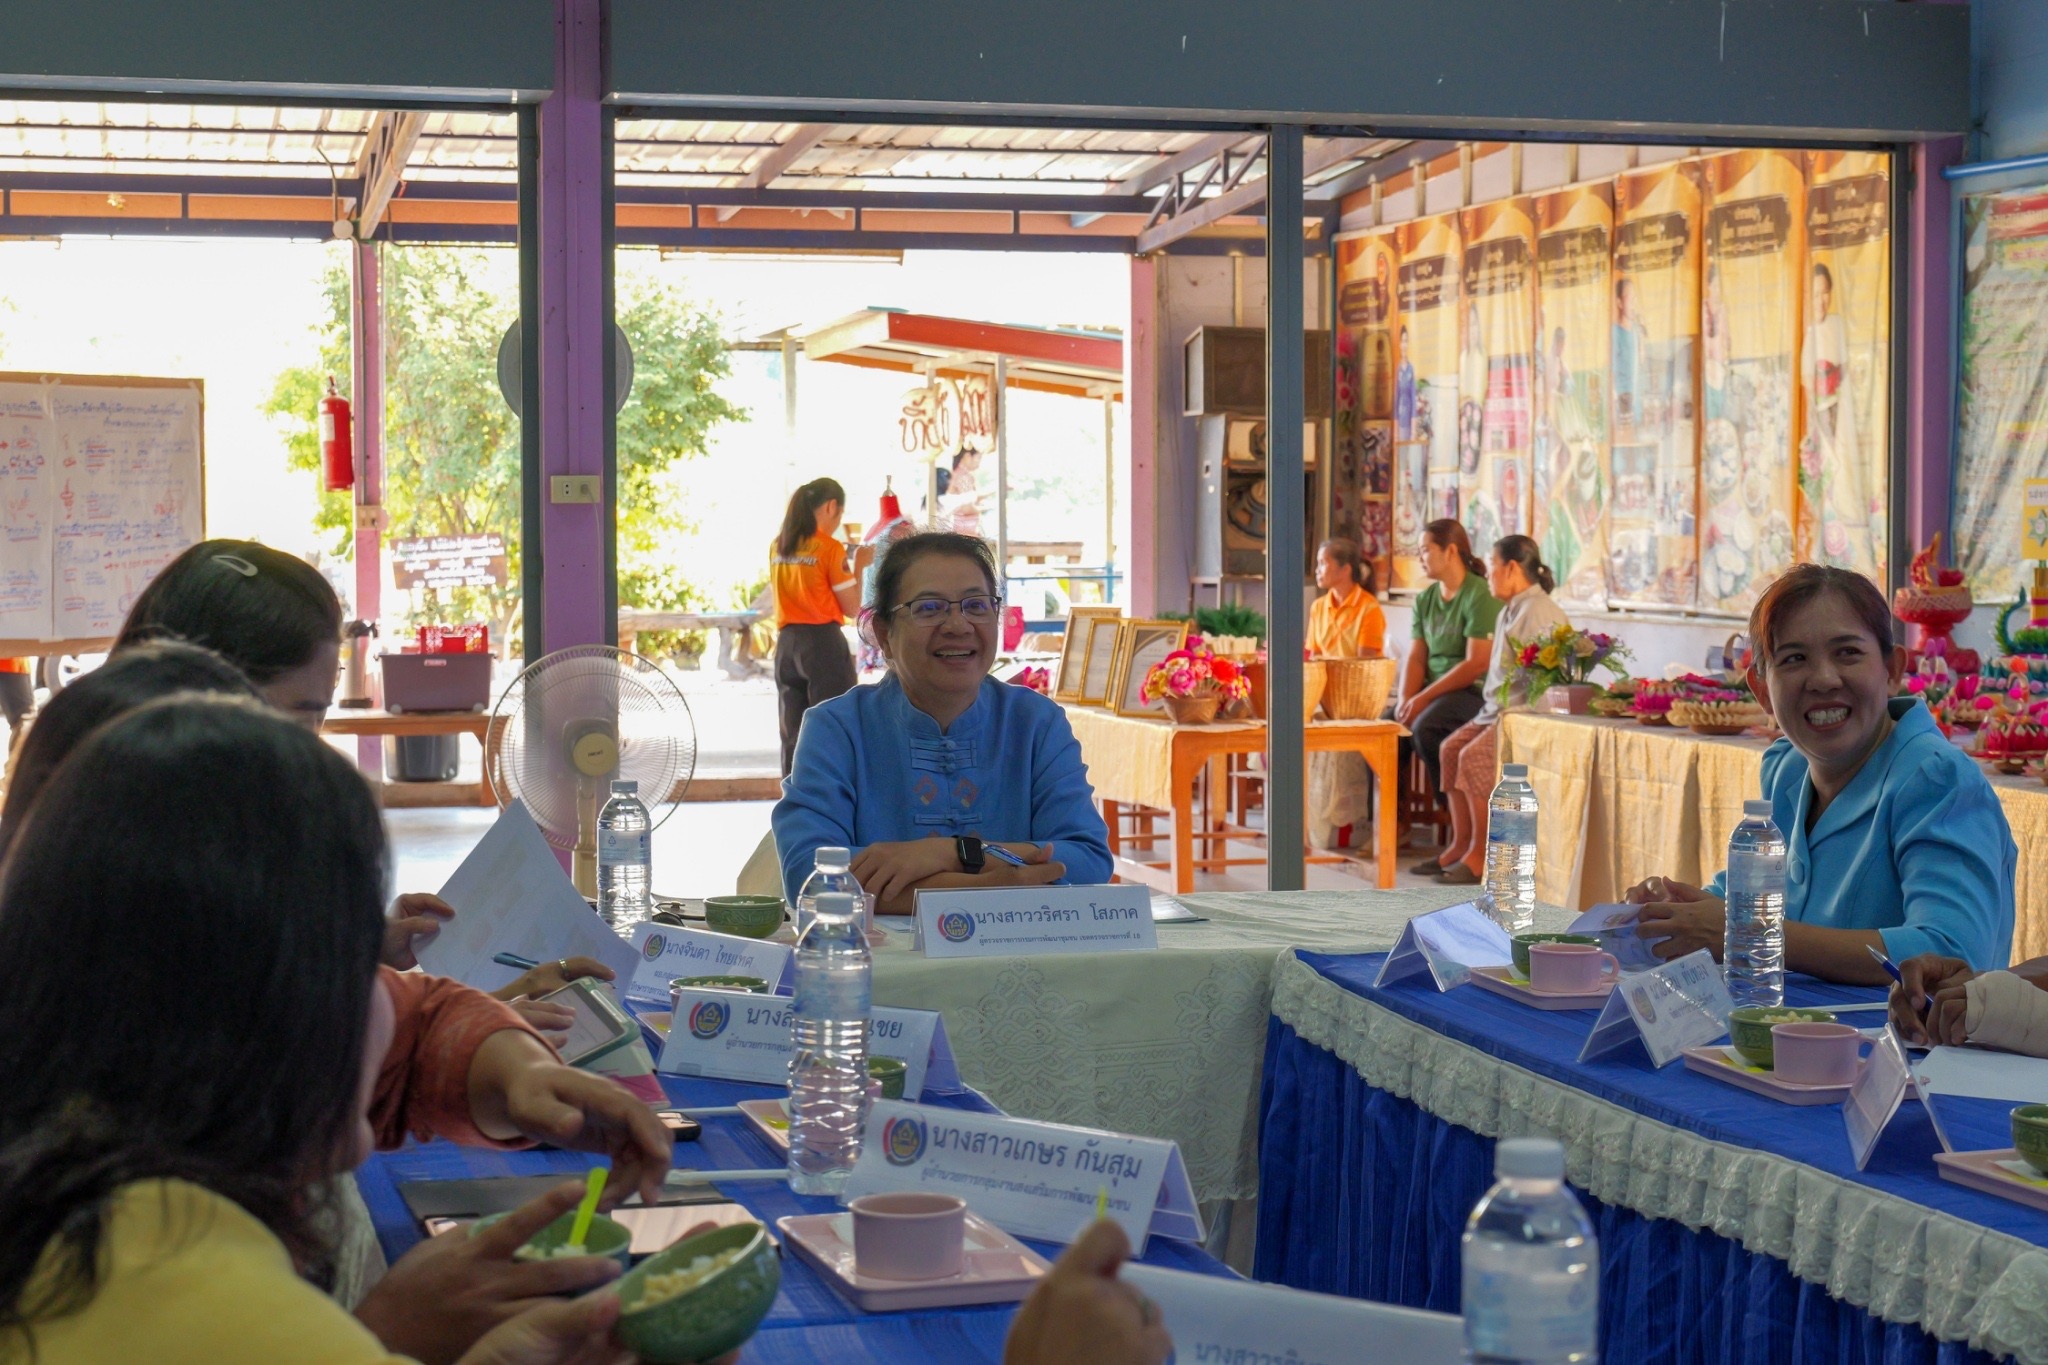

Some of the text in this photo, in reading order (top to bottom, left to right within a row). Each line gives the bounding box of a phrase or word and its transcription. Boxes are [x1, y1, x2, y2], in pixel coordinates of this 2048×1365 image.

[974, 902, 1139, 925] นางสาววริศรา โสภาค
[666, 941, 754, 968] นางจินดา ไทยเทศ
[933, 1125, 1143, 1187] นางสาวเกษร กันสุ่ม
